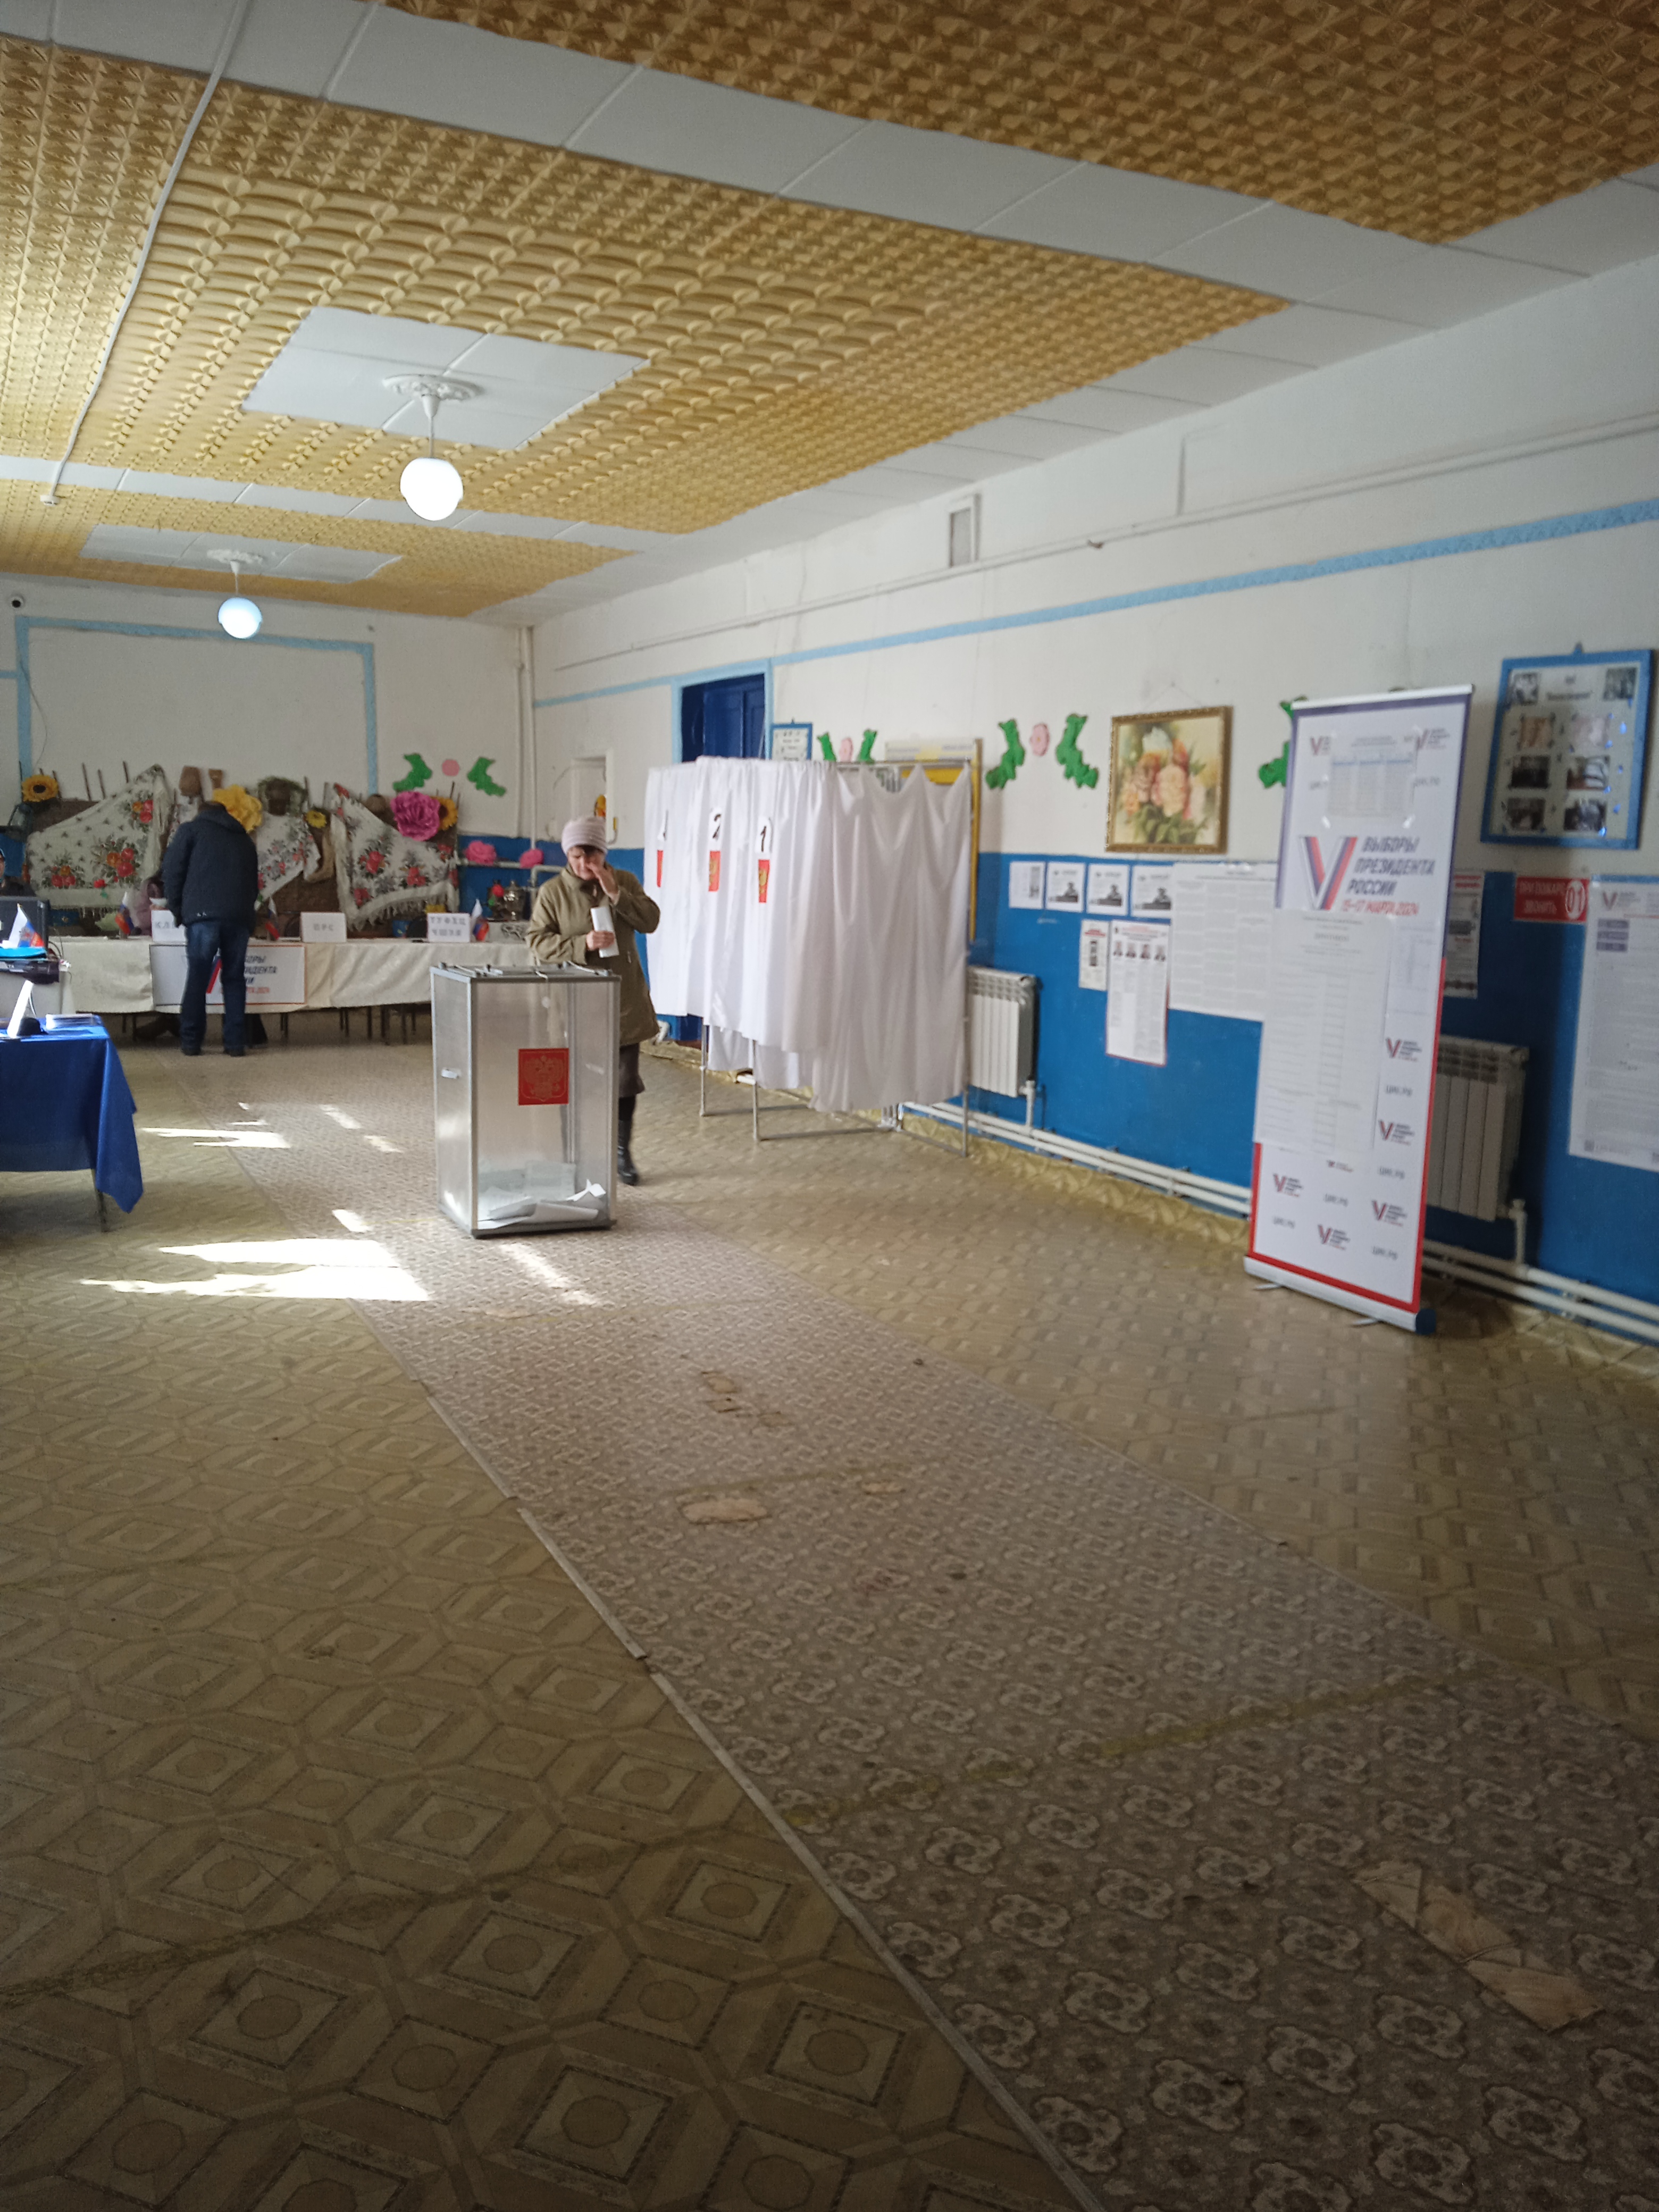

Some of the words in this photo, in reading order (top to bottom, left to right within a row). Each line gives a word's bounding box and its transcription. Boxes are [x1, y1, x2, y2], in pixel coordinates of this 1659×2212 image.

[760, 826, 767, 852] 1
[1362, 836, 1420, 852] ВЫБОРЫ
[1354, 858, 1436, 875] ПРЕЗИДЕНТА
[1346, 879, 1397, 896] РОССИИ
[1567, 886, 1585, 914] 01
